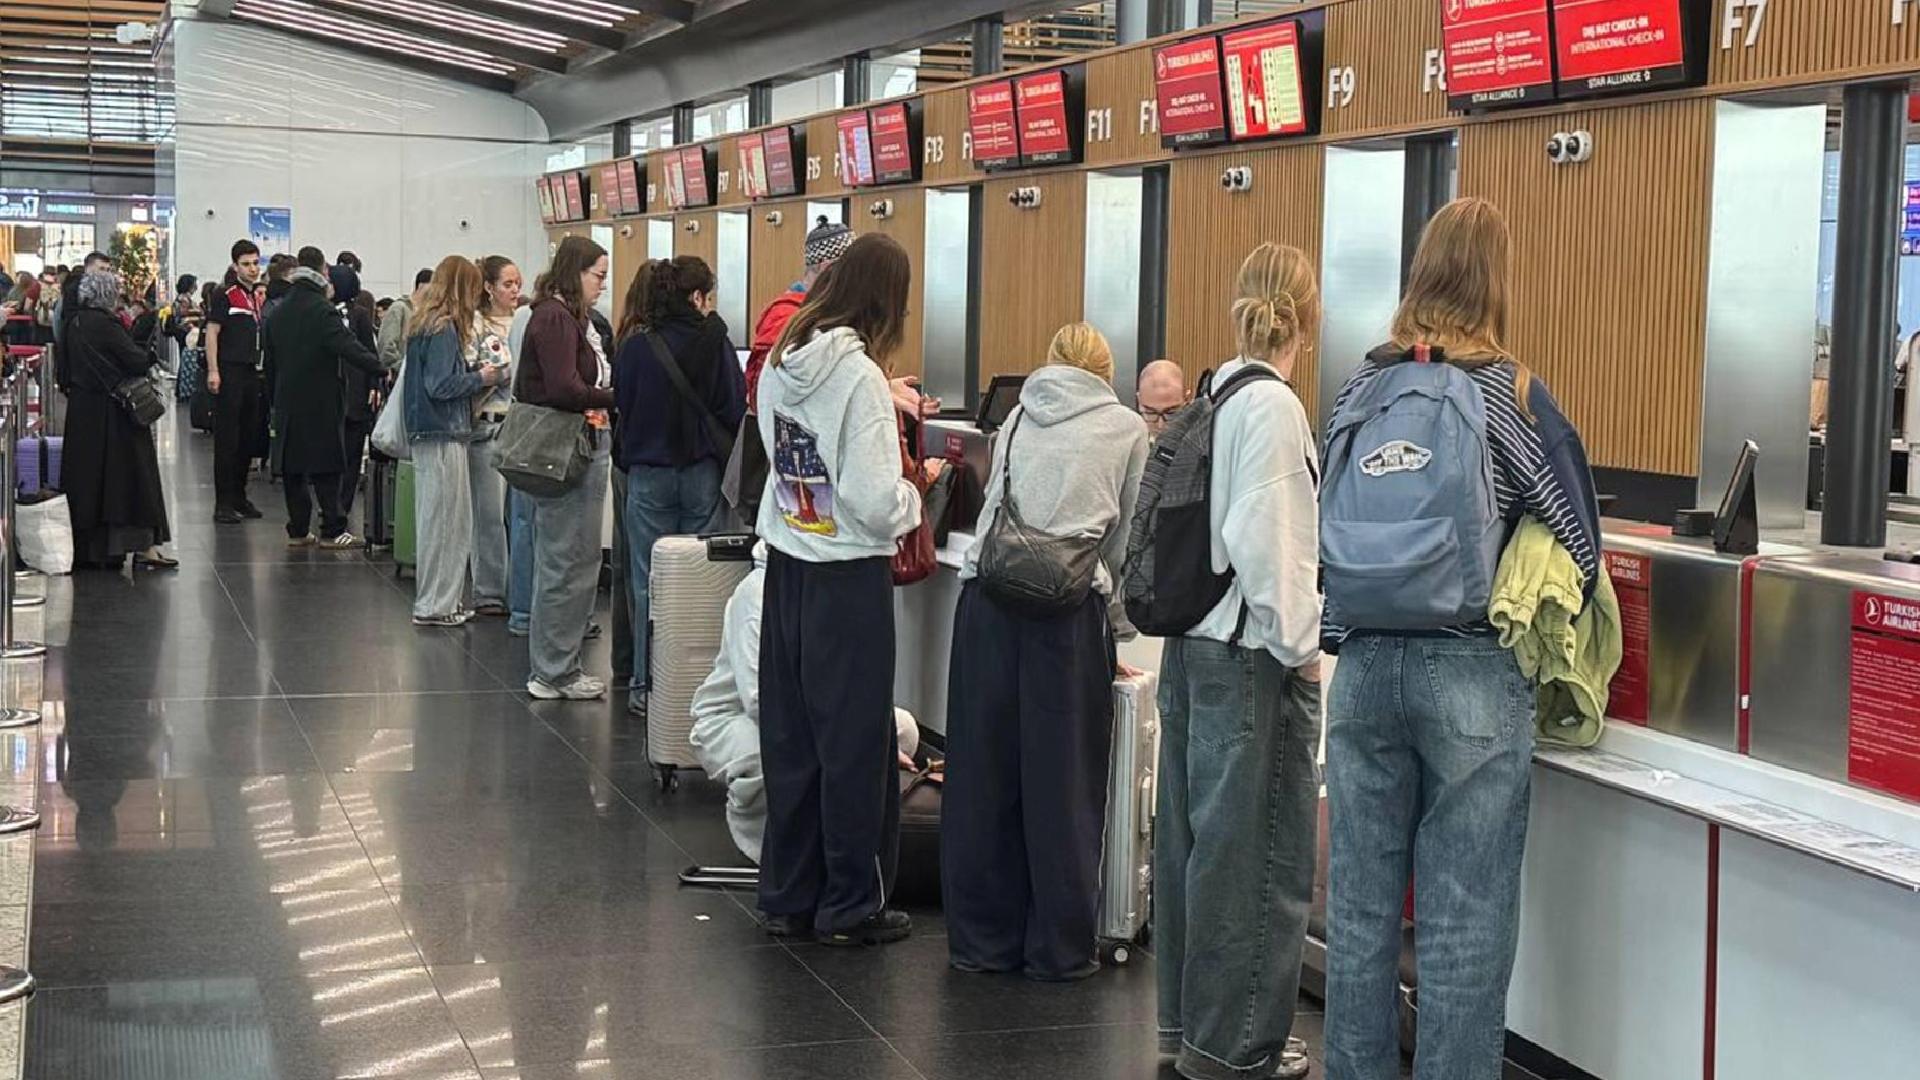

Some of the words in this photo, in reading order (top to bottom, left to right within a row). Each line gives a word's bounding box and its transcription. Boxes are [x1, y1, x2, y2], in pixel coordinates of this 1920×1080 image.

[1722, 0, 1768, 49] F7
[1571, 36, 1627, 54] INTERNATIONAL
[1327, 66, 1355, 109] F9
[1088, 108, 1112, 143] F11
[1139, 98, 1158, 135] F1
[925, 135, 944, 164] F13
[807, 156, 821, 180] F15
